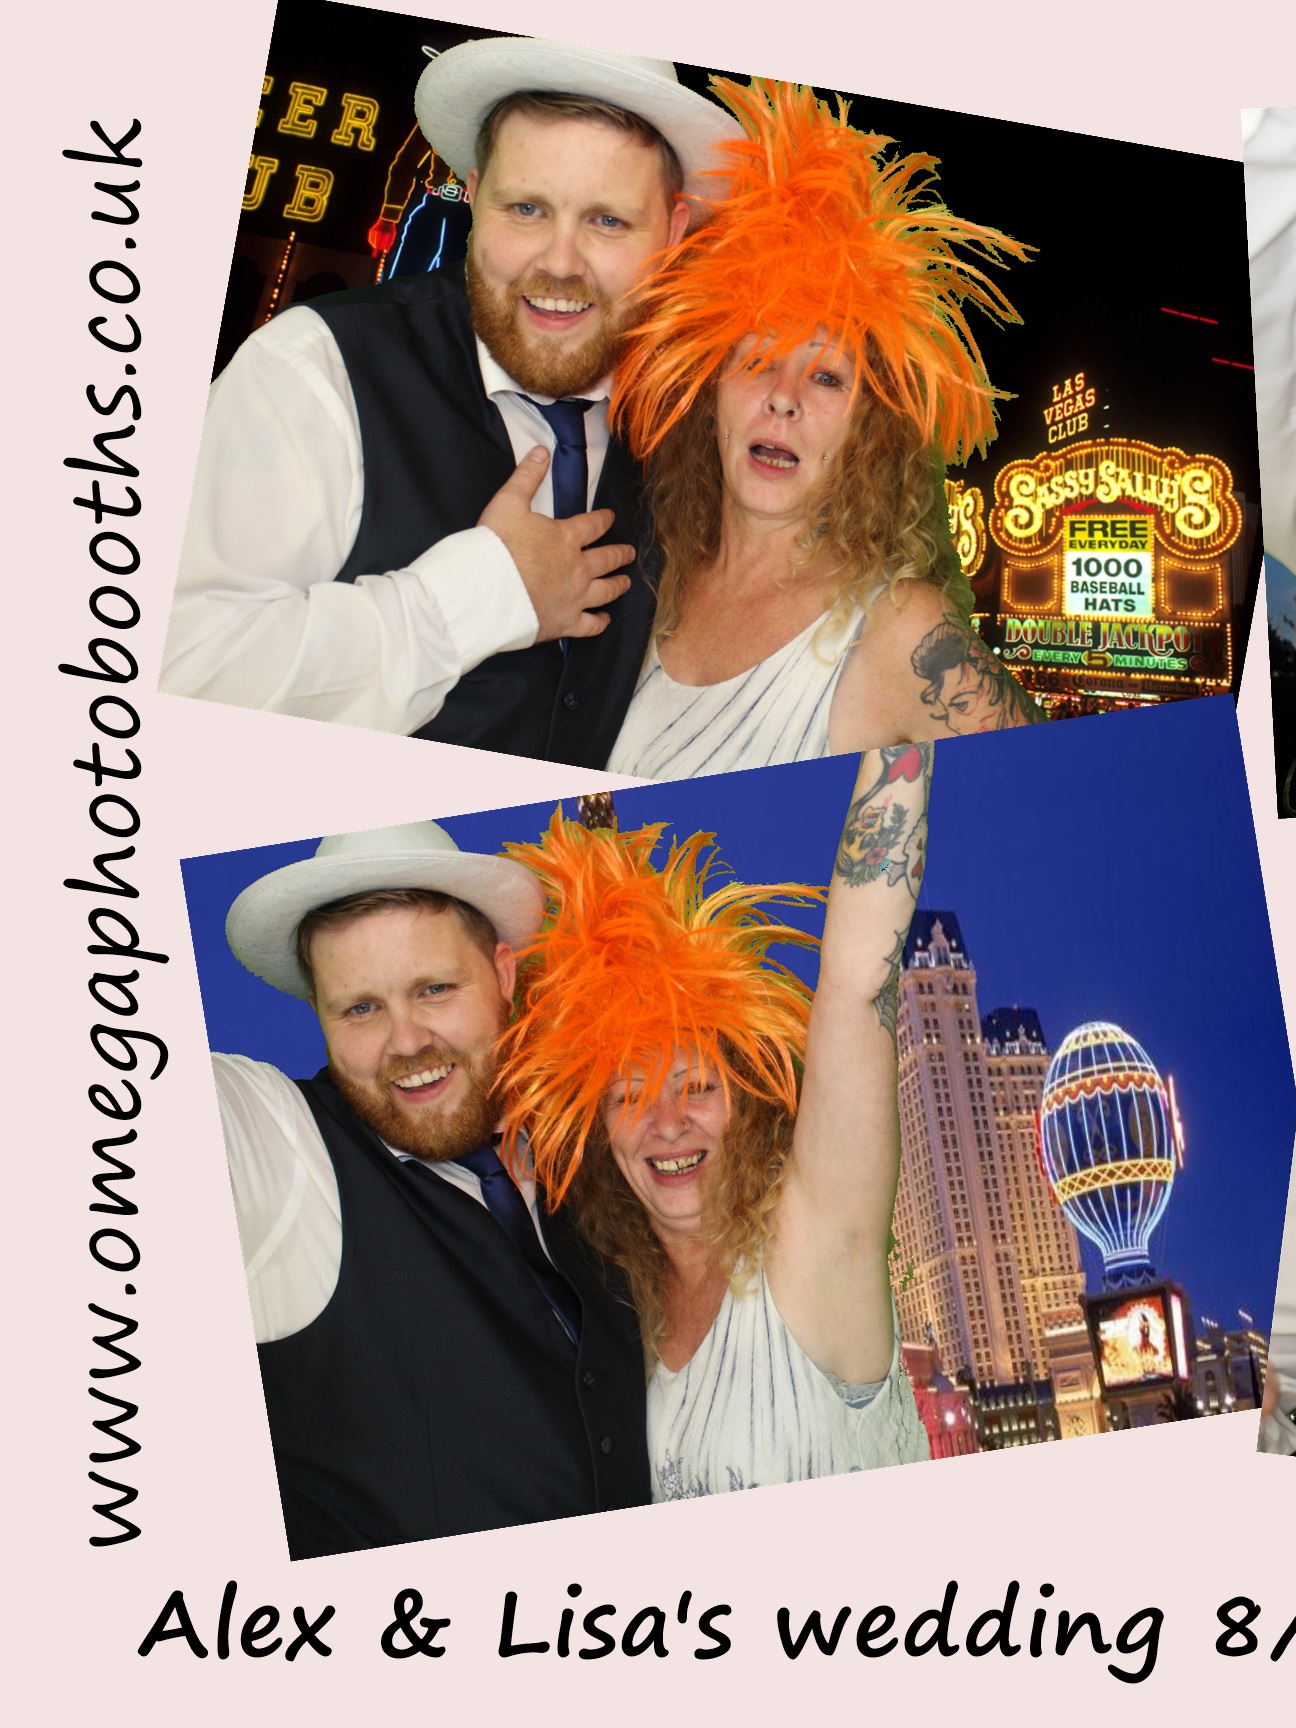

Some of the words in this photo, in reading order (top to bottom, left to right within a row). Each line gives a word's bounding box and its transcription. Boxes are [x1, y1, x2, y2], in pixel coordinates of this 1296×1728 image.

[256, 75, 380, 151] ER
[1052, 372, 1085, 402] LAS
[1043, 387, 1096, 425] VEGAS
[1048, 412, 1089, 444] CLUB
[1069, 520, 1148, 538] FREE
[1069, 540, 1148, 550] EVERYDAY
[1071, 557, 1143, 578] 1000
[1070, 580, 1145, 595] BASEBALL
[1084, 597, 1136, 613] HATS
[1005, 617, 1093, 648] DOUBLE
[1032, 649, 1081, 664] EVERY
[1114, 654, 1189, 671] MINUTES
[1072, 674, 1126, 692] Corona
